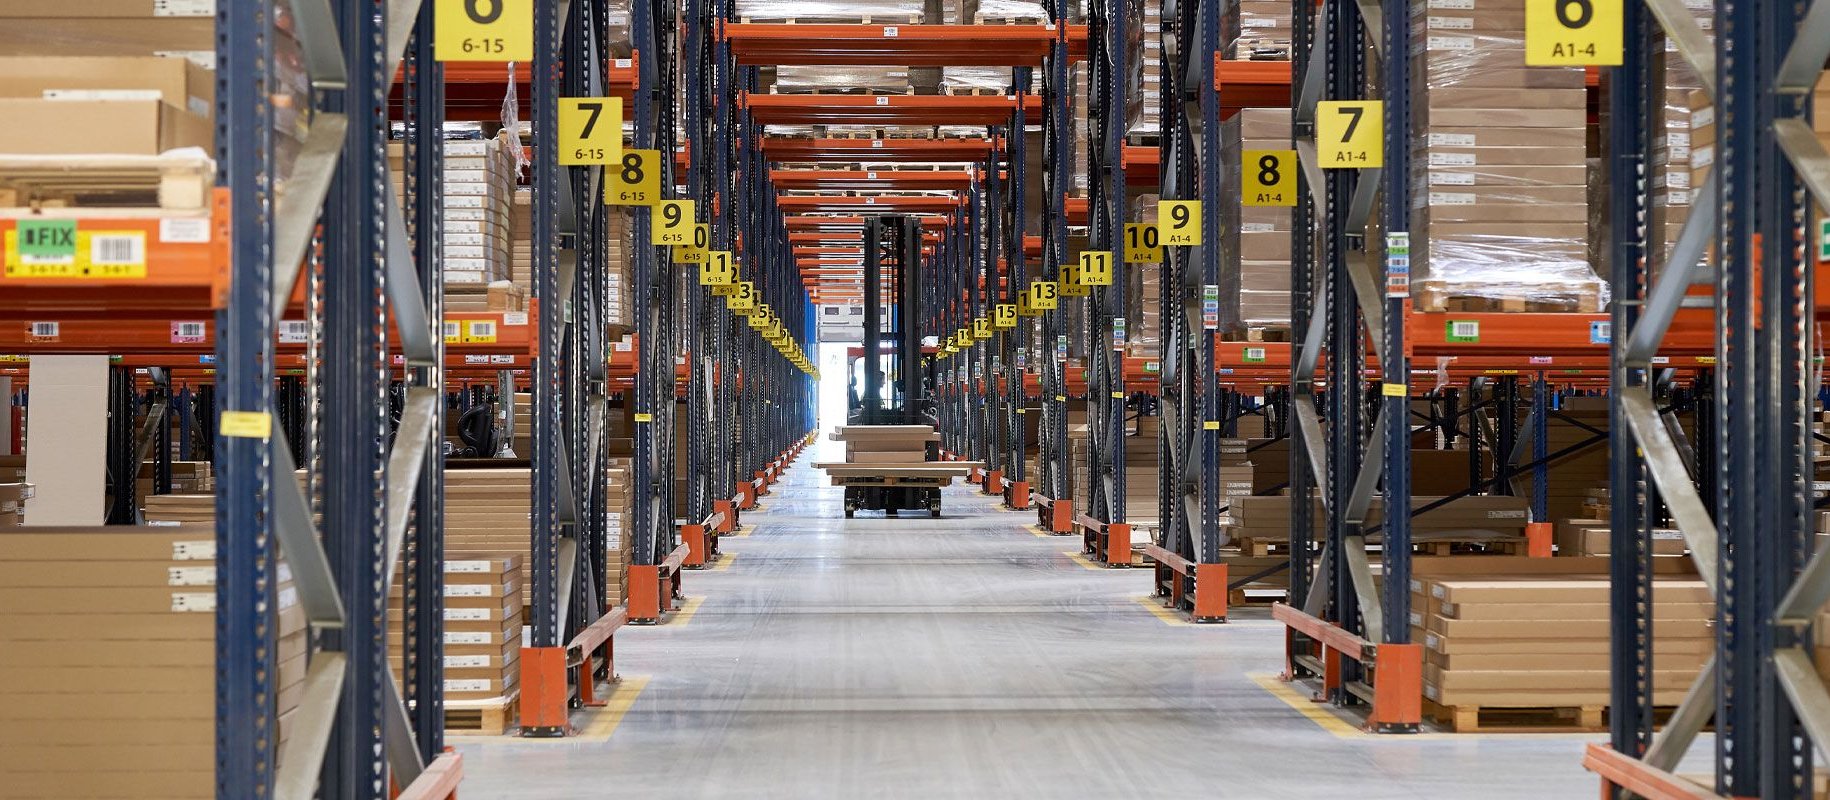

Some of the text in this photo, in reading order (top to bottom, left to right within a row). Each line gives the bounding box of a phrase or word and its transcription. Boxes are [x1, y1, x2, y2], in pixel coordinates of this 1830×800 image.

[462, 38, 504, 53] 6-15
[1552, 43, 1596, 57] A1-4
[577, 103, 603, 139] 7
[1338, 107, 1364, 143] 7
[575, 149, 604, 160] 6-15
[1336, 151, 1367, 162] A1-4
[620, 153, 644, 185] 8
[1258, 155, 1281, 186] 8
[620, 191, 645, 201] 6-15
[1256, 193, 1282, 203] A1-4
[663, 203, 682, 228] 9
[1171, 204, 1190, 229] 9
[38, 227, 74, 246] FIX
[662, 234, 682, 242] 6-15
[1127, 226, 1159, 249] 10
[1170, 235, 1191, 243] A1-4
[1082, 254, 1104, 272] 11
[1133, 253, 1152, 261] A1-4
[1034, 284, 1056, 299] 13
[997, 306, 1016, 318] 15
